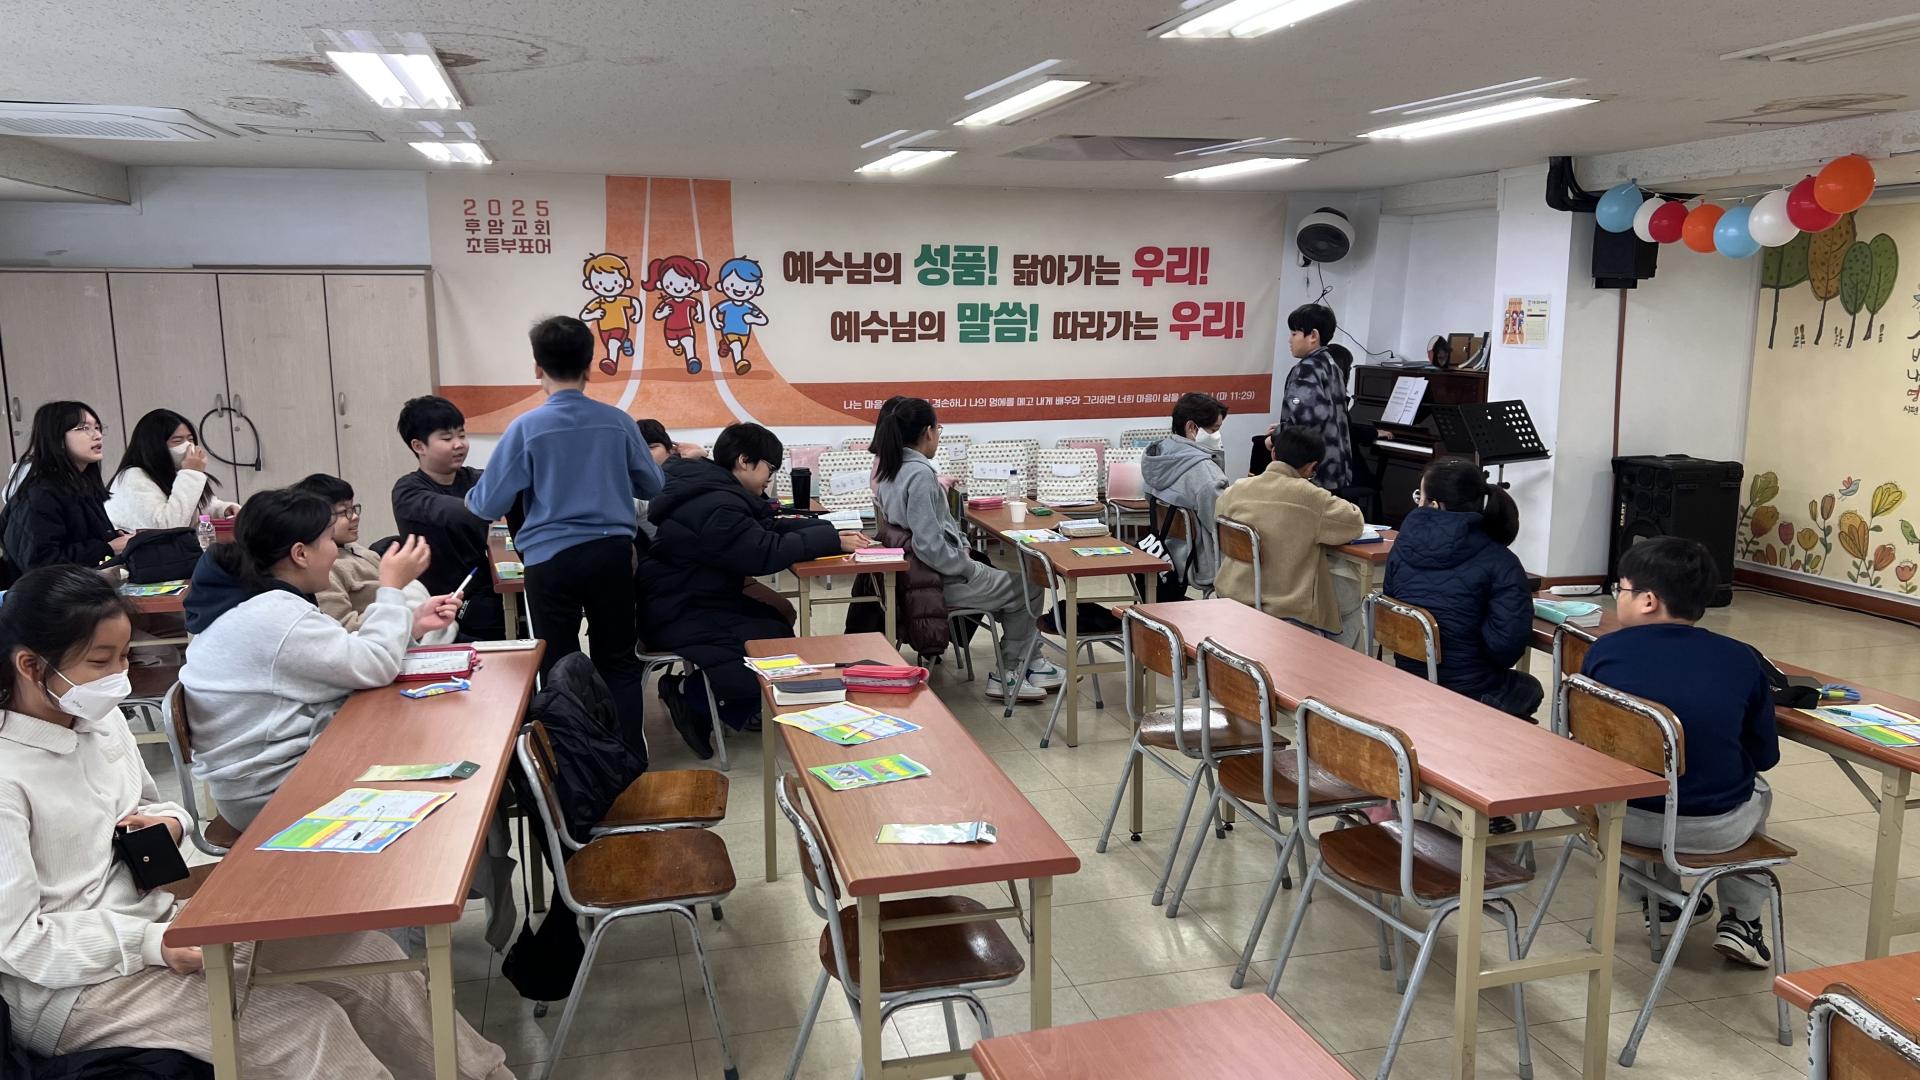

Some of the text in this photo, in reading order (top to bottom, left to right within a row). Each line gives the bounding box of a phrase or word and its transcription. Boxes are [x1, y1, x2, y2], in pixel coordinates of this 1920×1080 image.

[463, 199, 550, 217] 2025
[464, 218, 551, 236] 후암교회
[466, 237, 552, 254] 초등부표어
[783, 244, 1210, 287] 예수님의 성품! 닮아가는 우리!
[830, 301, 1245, 344] 예수님의 말씀! 따라가는 우리!
[843, 400, 862, 410] 나는
[932, 397, 968, 409] 겸손하니
[969, 397, 986, 408] 나의
[989, 397, 1014, 408] 멍에를
[1017, 396, 1034, 406] 메고
[1036, 396, 1053, 406] 내게
[1055, 395, 1080, 405] 배우라
[1083, 394, 1115, 405] 그리하면
[1117, 394, 1135, 404] 너희
[1136, 393, 1160, 404] 마음이
[1162, 393, 1180, 403] 쉼을
[1216, 391, 1228, 401] (마
[1230, 390, 1256, 401] 11:29)
